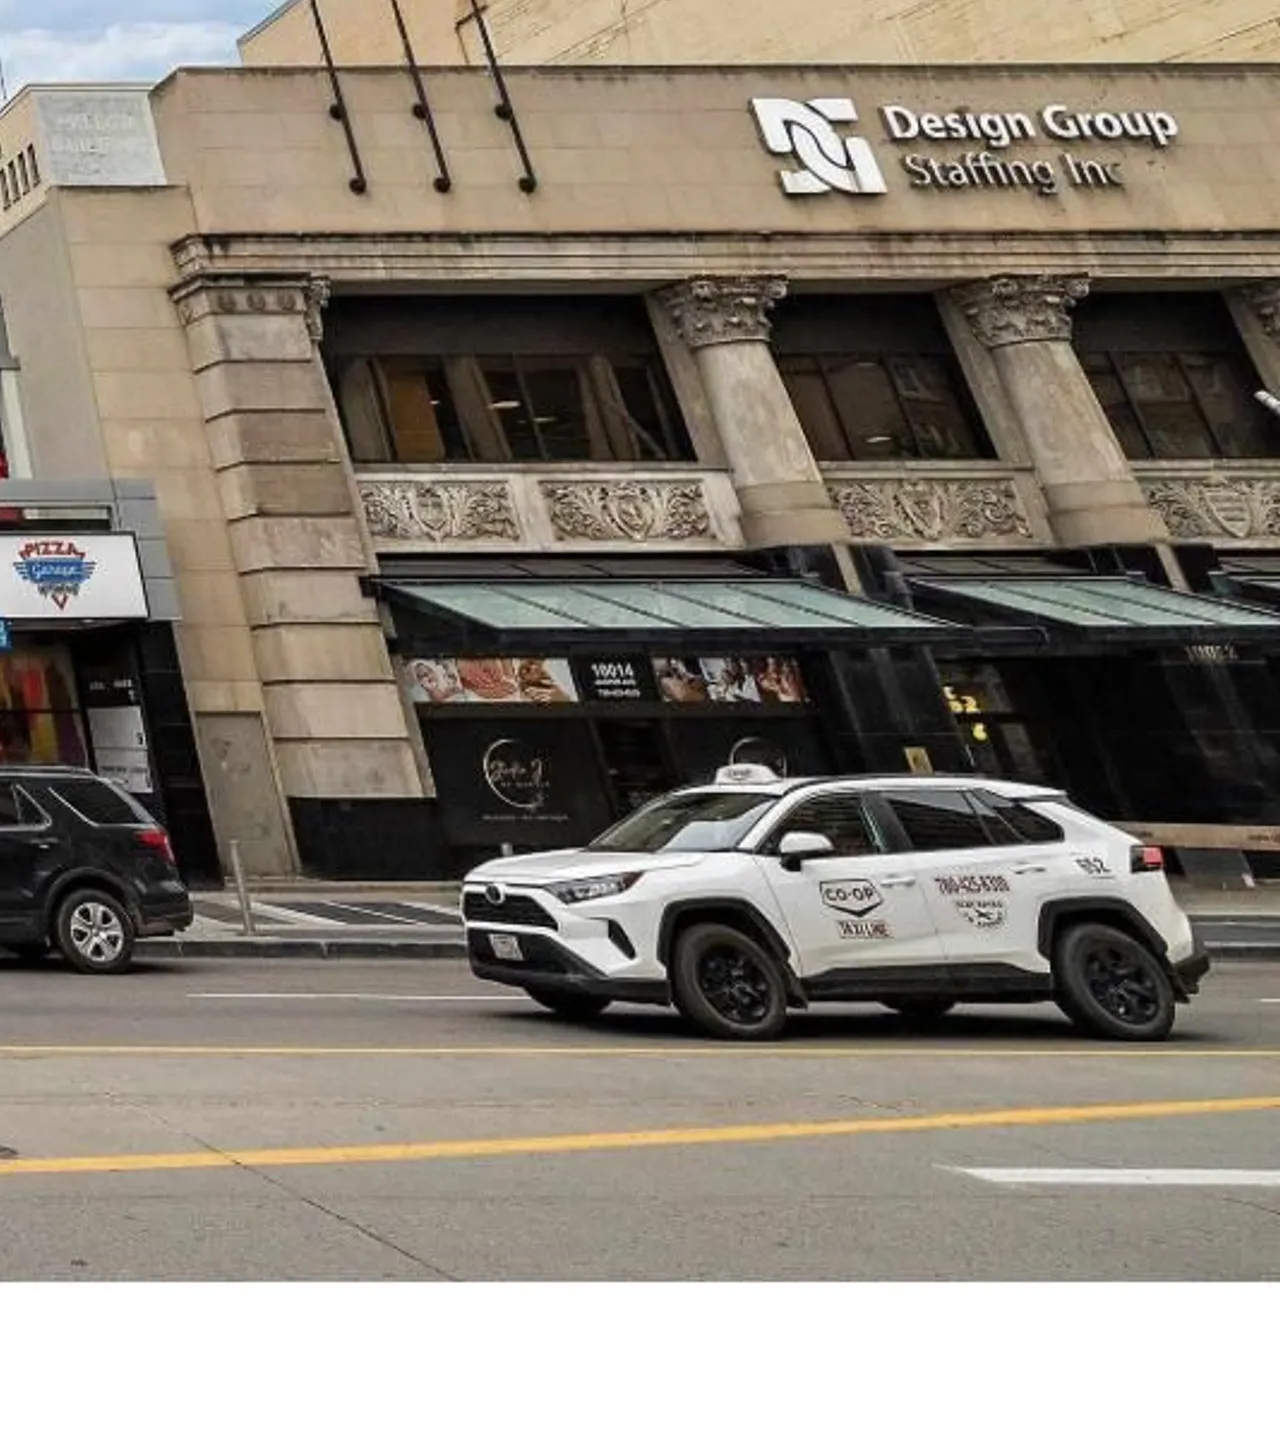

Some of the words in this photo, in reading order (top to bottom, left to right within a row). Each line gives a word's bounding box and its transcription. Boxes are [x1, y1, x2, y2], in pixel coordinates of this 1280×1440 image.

[883, 106, 1037, 148] Design
[1041, 104, 1180, 147] Group
[906, 153, 1053, 193] Staffing
[24, 541, 80, 557] PIZZA
[825, 887, 875, 903] CO-OP
